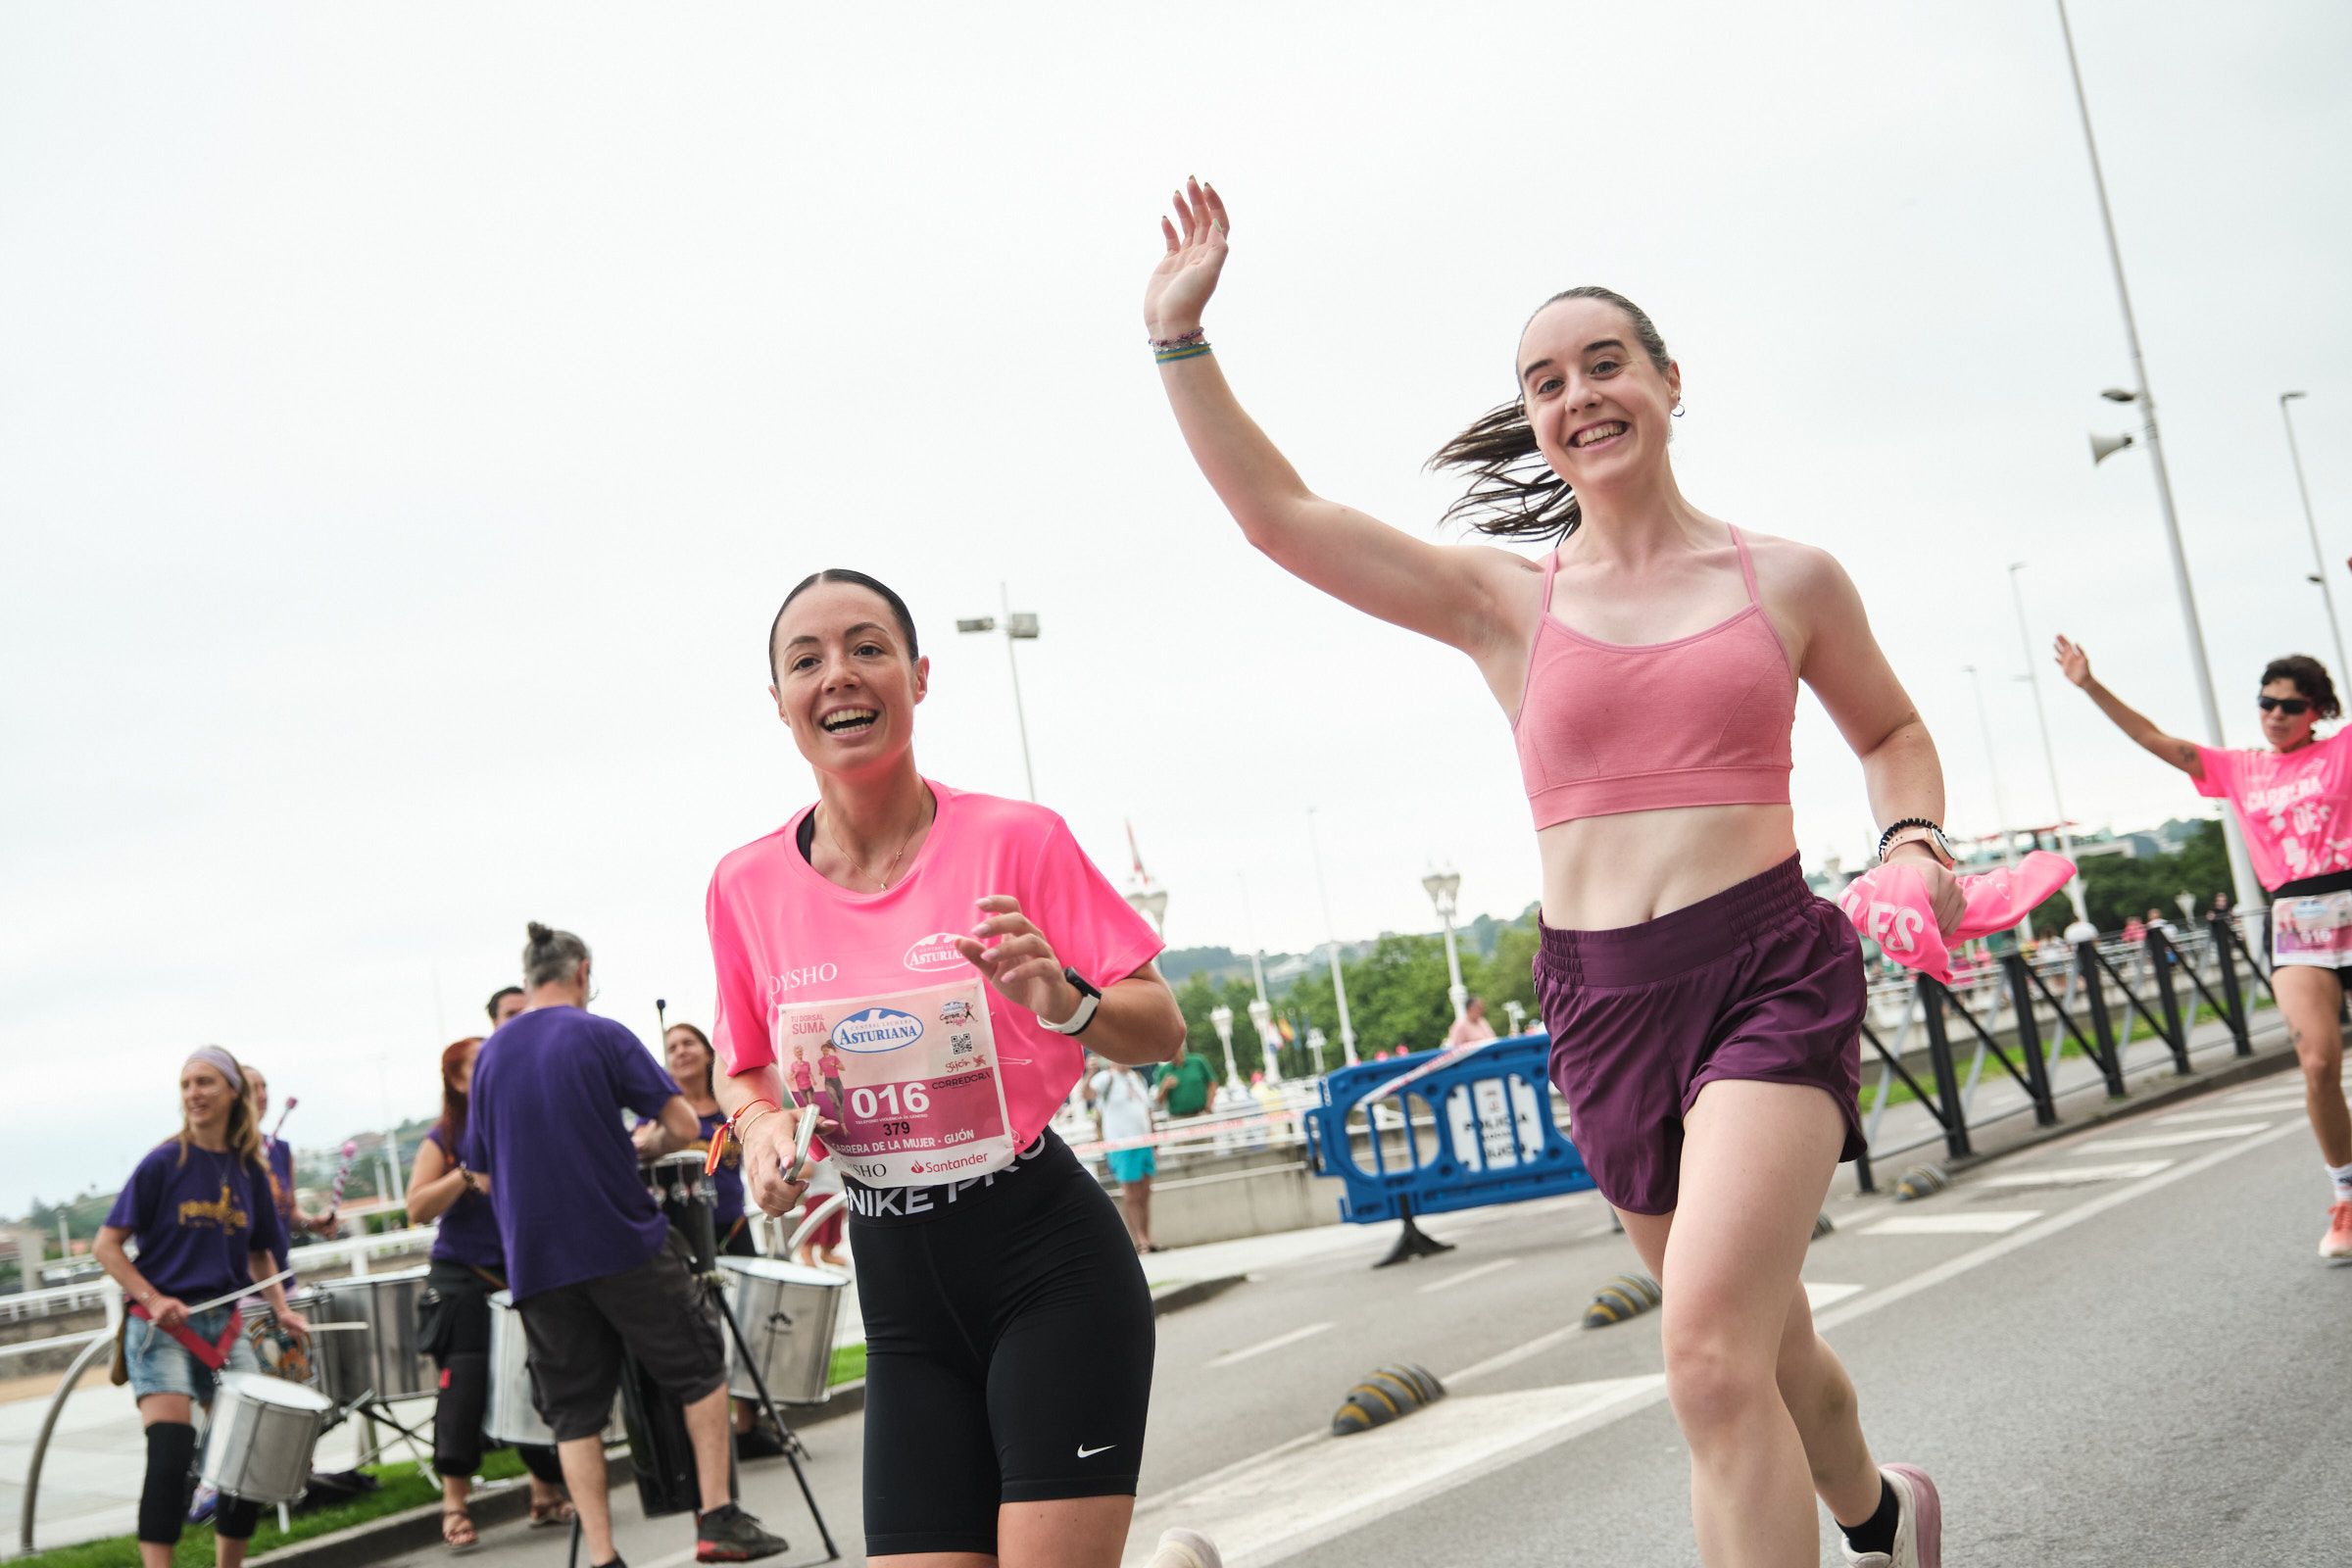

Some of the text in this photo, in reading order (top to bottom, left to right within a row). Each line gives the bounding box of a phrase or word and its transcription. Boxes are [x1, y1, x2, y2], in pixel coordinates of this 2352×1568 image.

[908, 950, 966, 966] ASTURIA
[792, 1021, 828, 1035] SUMA
[839, 1025, 918, 1046] ASTURIANA
[851, 1082, 930, 1119] 016
[883, 1121, 910, 1137] 379
[872, 1141, 886, 1152] DE
[887, 1140, 901, 1151] LA
[903, 1137, 936, 1149] MUJER
[944, 1129, 975, 1145] GIJÓN
[925, 1152, 989, 1174] Santander
[847, 1184, 934, 1217] NIKE
